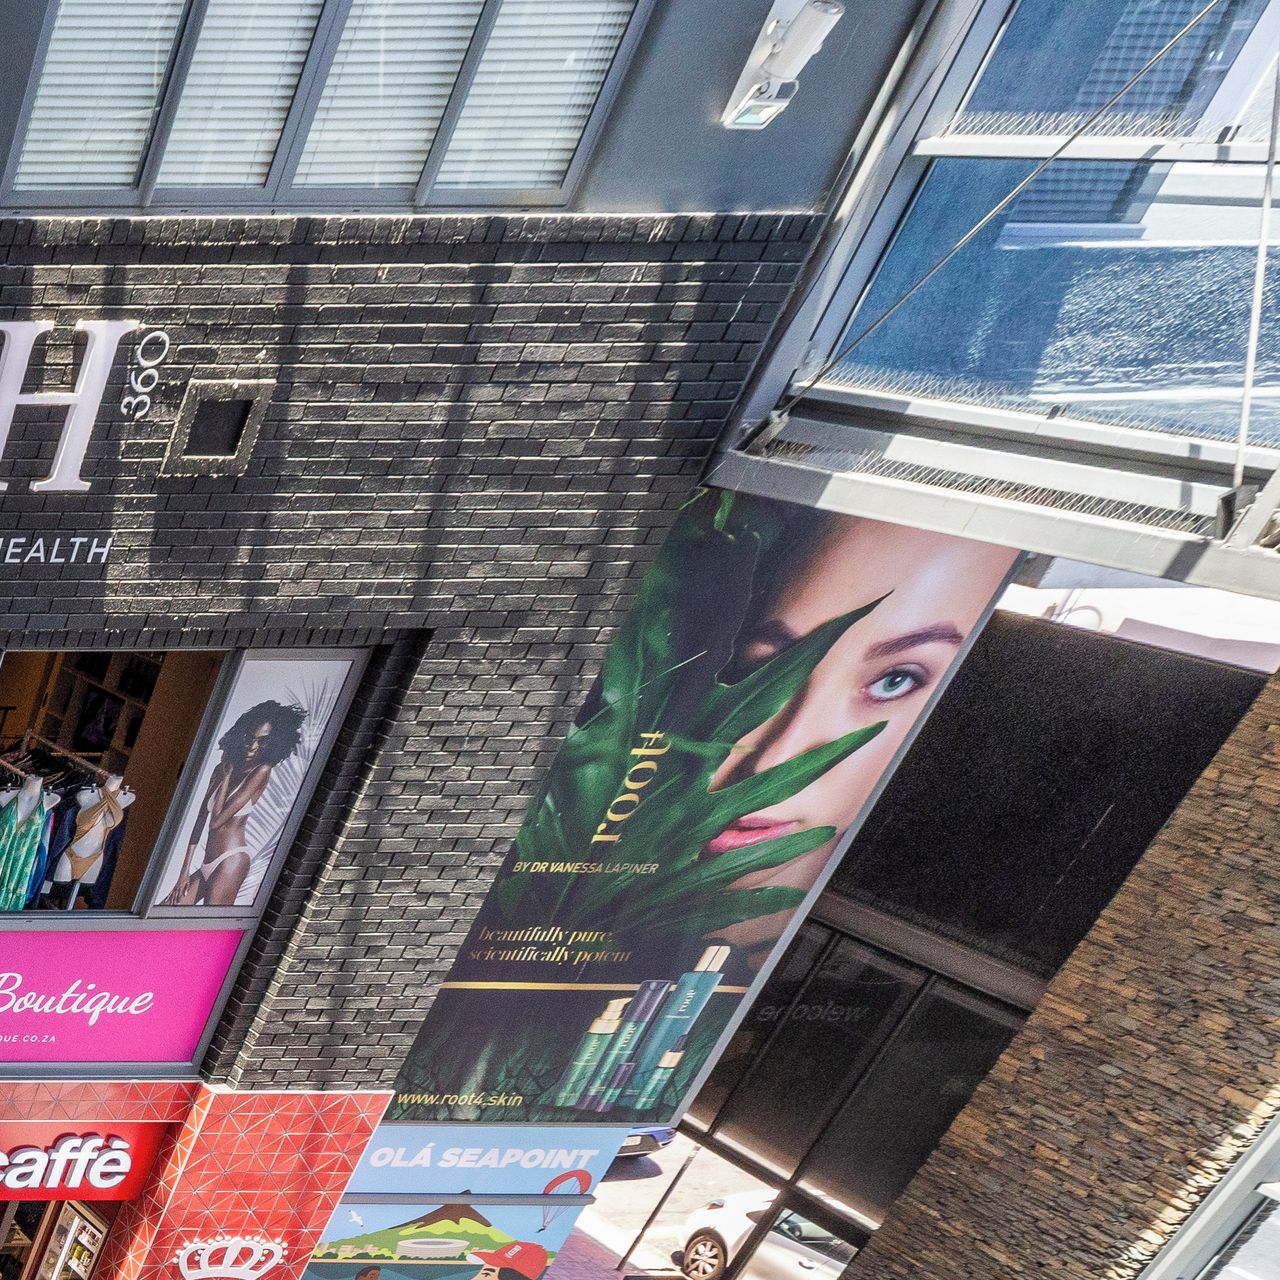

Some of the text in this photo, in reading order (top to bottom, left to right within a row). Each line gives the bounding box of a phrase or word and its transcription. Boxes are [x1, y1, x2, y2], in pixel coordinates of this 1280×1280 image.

[513, 862, 660, 874] BY DR VANESSA LAPINER
[479, 927, 569, 946] beautifully
[470, 946, 633, 966] scientifically potent
[395, 1090, 523, 1109] www.root4.skin
[370, 1142, 601, 1169] OLÁ SEAPOINT
